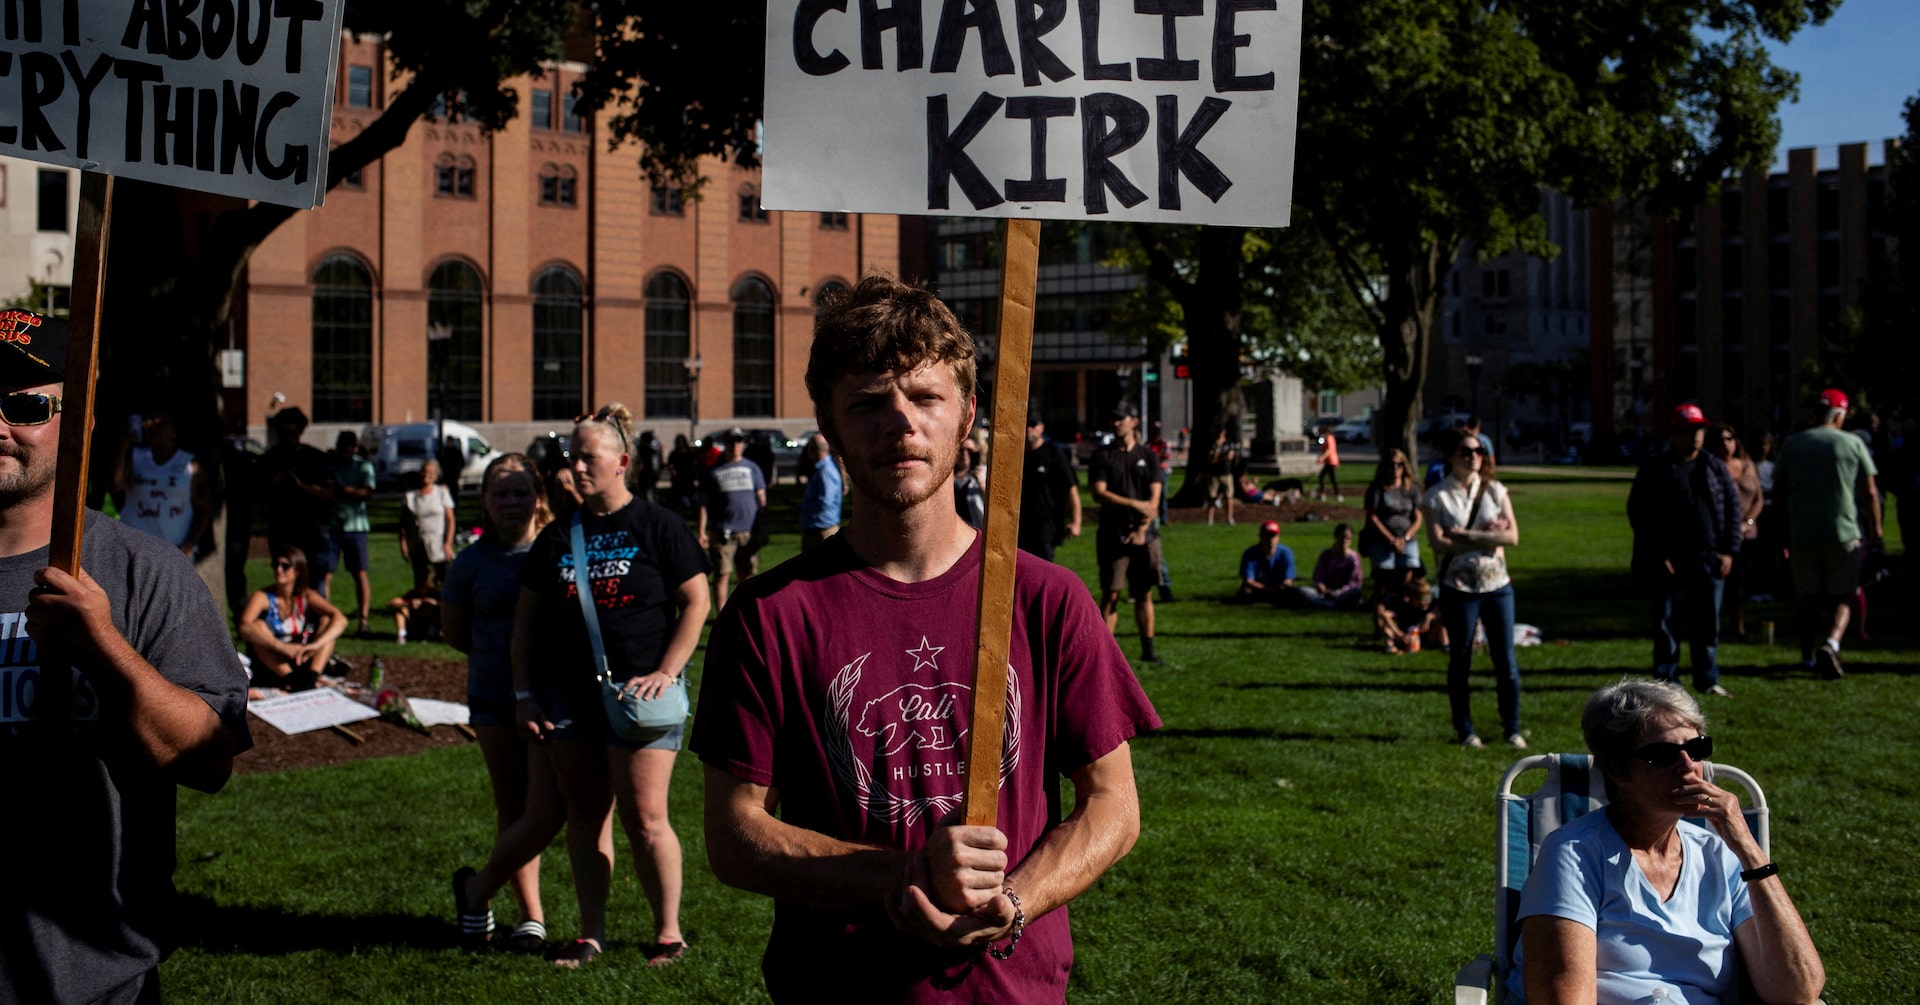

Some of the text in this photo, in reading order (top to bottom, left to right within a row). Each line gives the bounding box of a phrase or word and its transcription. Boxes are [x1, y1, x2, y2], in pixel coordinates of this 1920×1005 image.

[121, 0, 323, 73] ABOUT
[793, 0, 1277, 92] CHARLIE
[926, 90, 1233, 215] KIRK
[557, 559, 631, 582] MKES
[899, 694, 957, 722] Cali
[894, 761, 965, 780] HUSTLE
